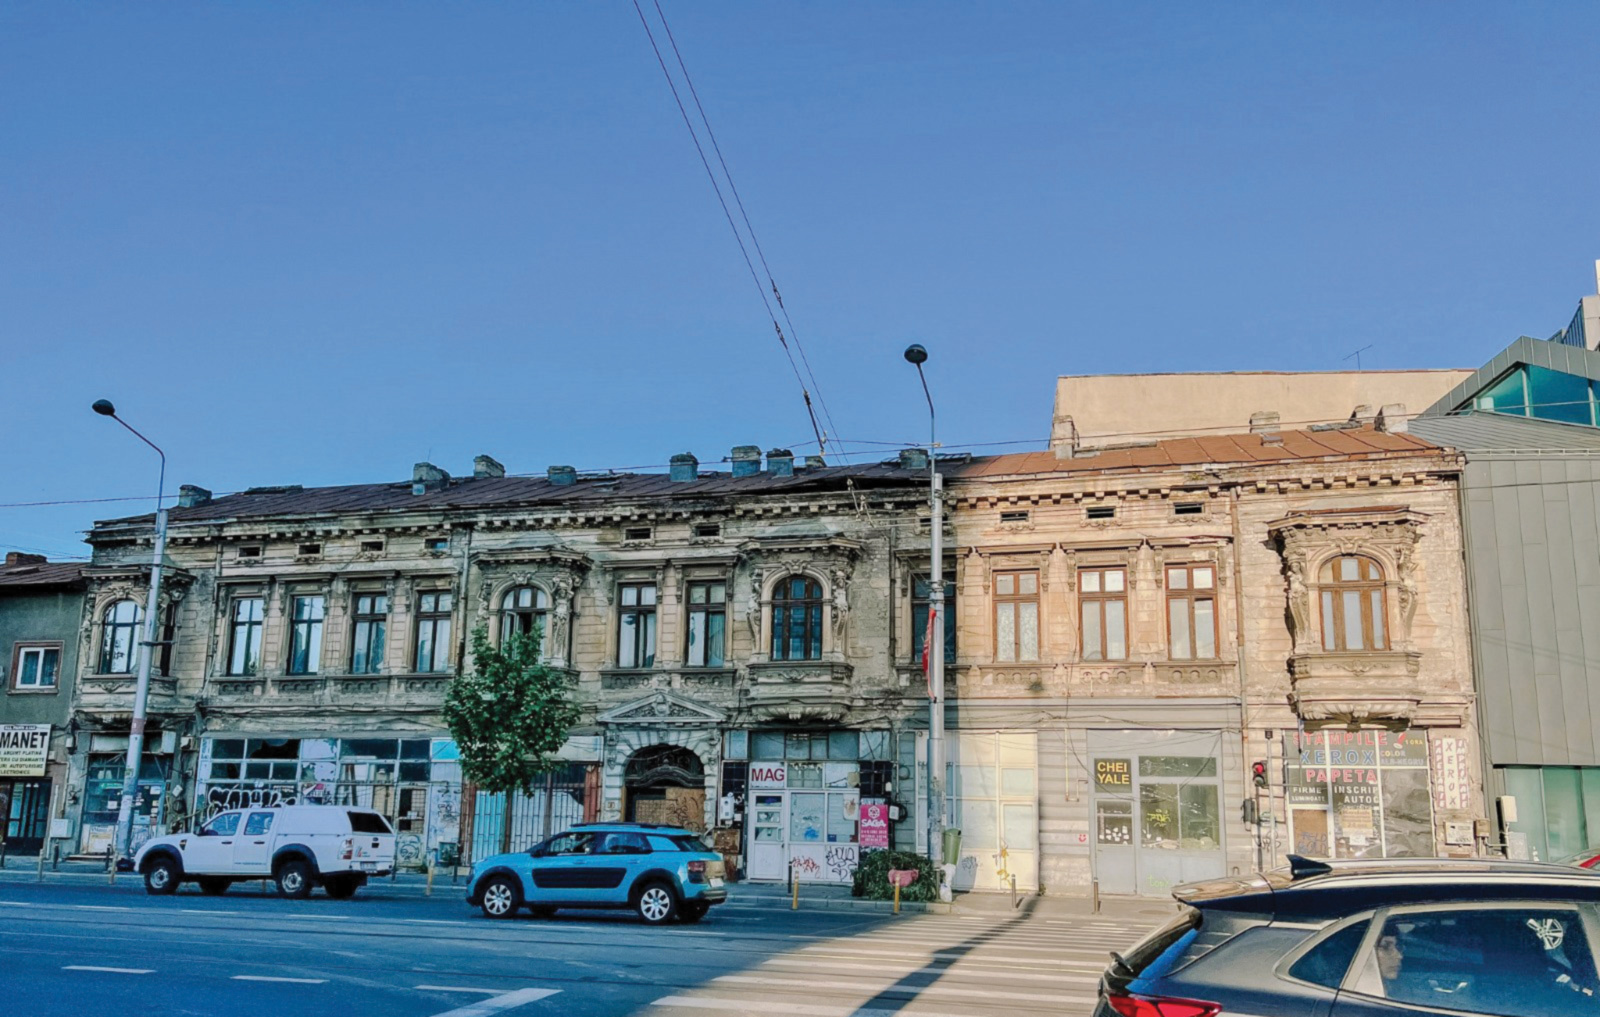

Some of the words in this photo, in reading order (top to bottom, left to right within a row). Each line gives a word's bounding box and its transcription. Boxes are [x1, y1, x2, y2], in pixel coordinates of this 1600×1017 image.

[1292, 731, 1388, 746] STAMPILE
[1301, 749, 1375, 765] XEROX
[1097, 762, 1127, 773] CHEI
[1445, 742, 1457, 805] XEROX
[751, 768, 785, 781] MAG
[1097, 774, 1130, 784] YALE
[1306, 769, 1376, 783] PAPETA
[1293, 786, 1322, 794] FIRME
[1334, 785, 1379, 794] INSCRIP
[861, 818, 886, 827] SAGA
